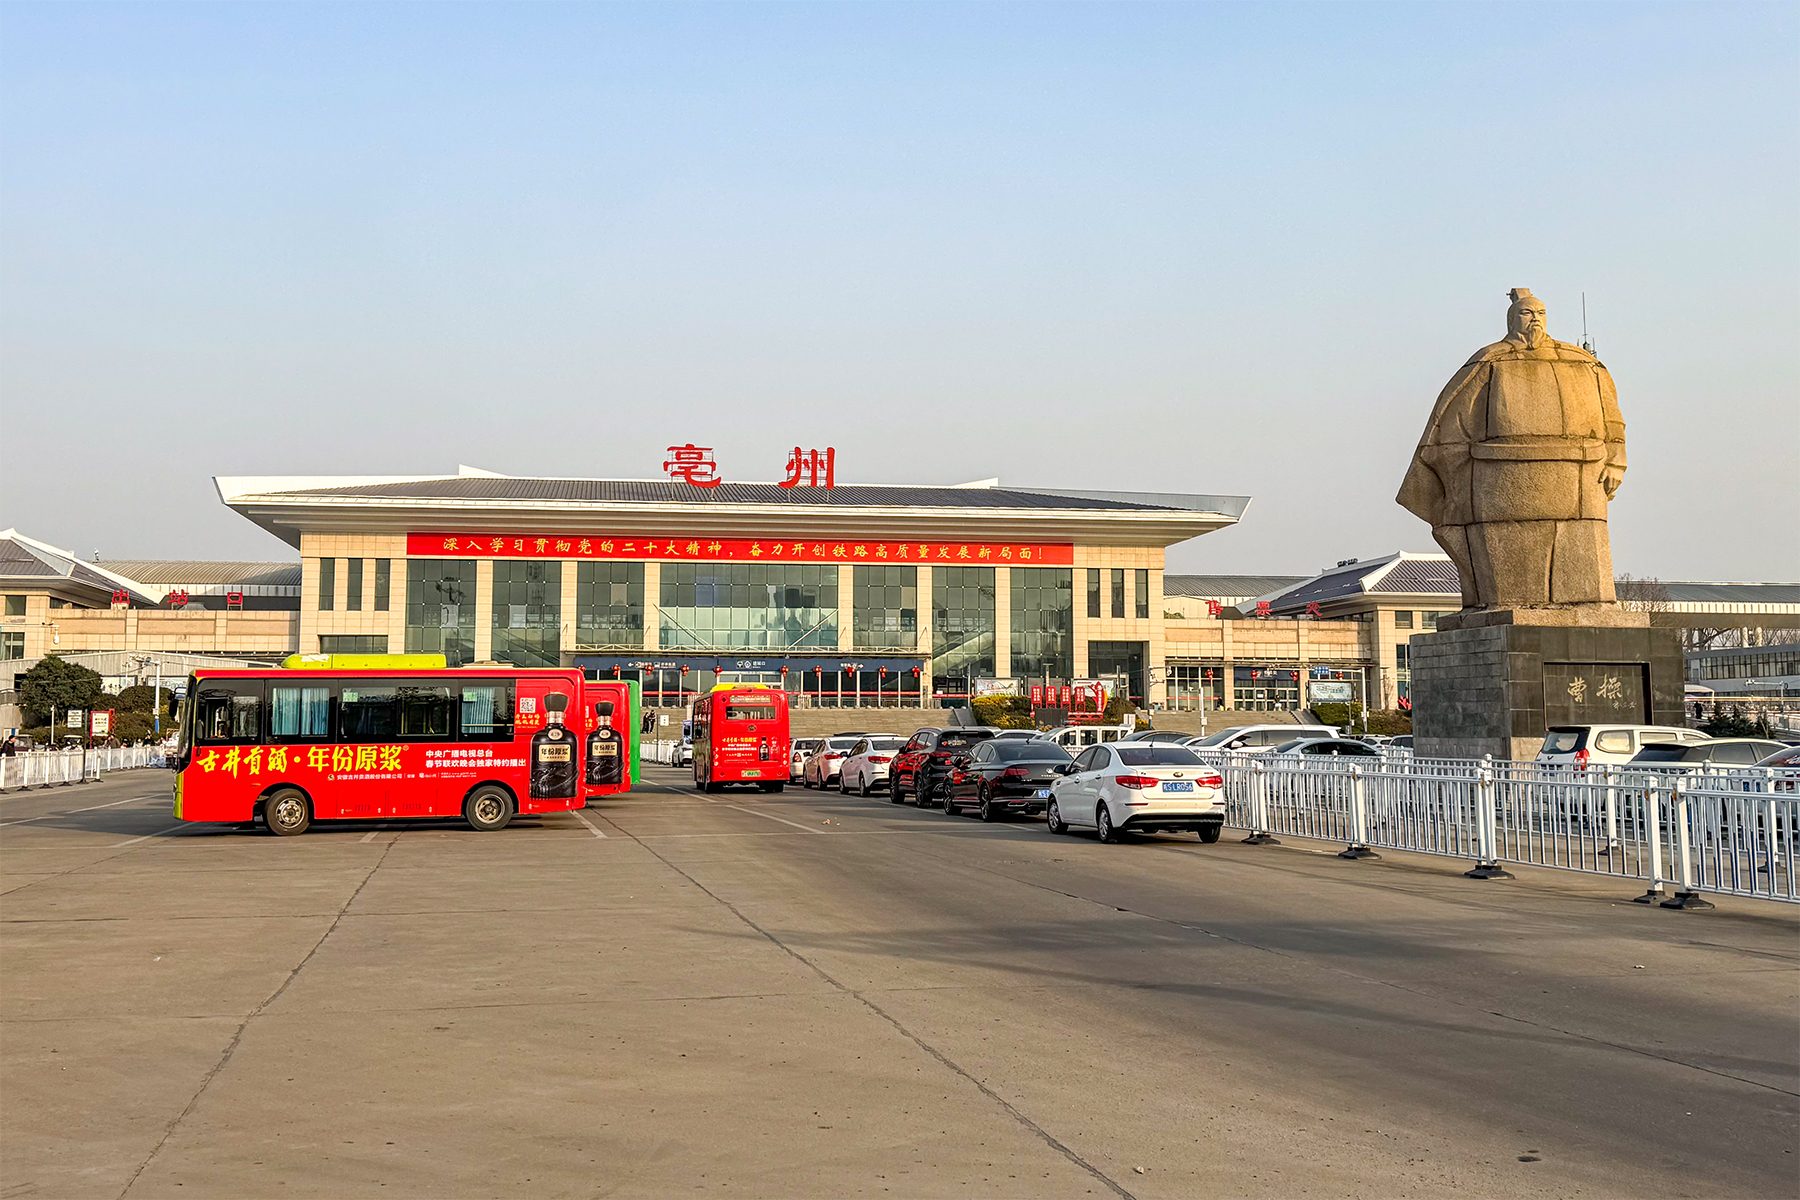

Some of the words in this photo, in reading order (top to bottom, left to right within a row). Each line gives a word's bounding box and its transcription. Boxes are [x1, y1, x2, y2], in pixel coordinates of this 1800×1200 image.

[663, 444, 835, 490] 亳州
[111, 588, 244, 606] 出站口
[1567, 673, 1623, 703] 曹操
[425, 749, 494, 758] 中央广播电视总台
[425, 758, 527, 768] 春节联欢晚会独家特约播出
